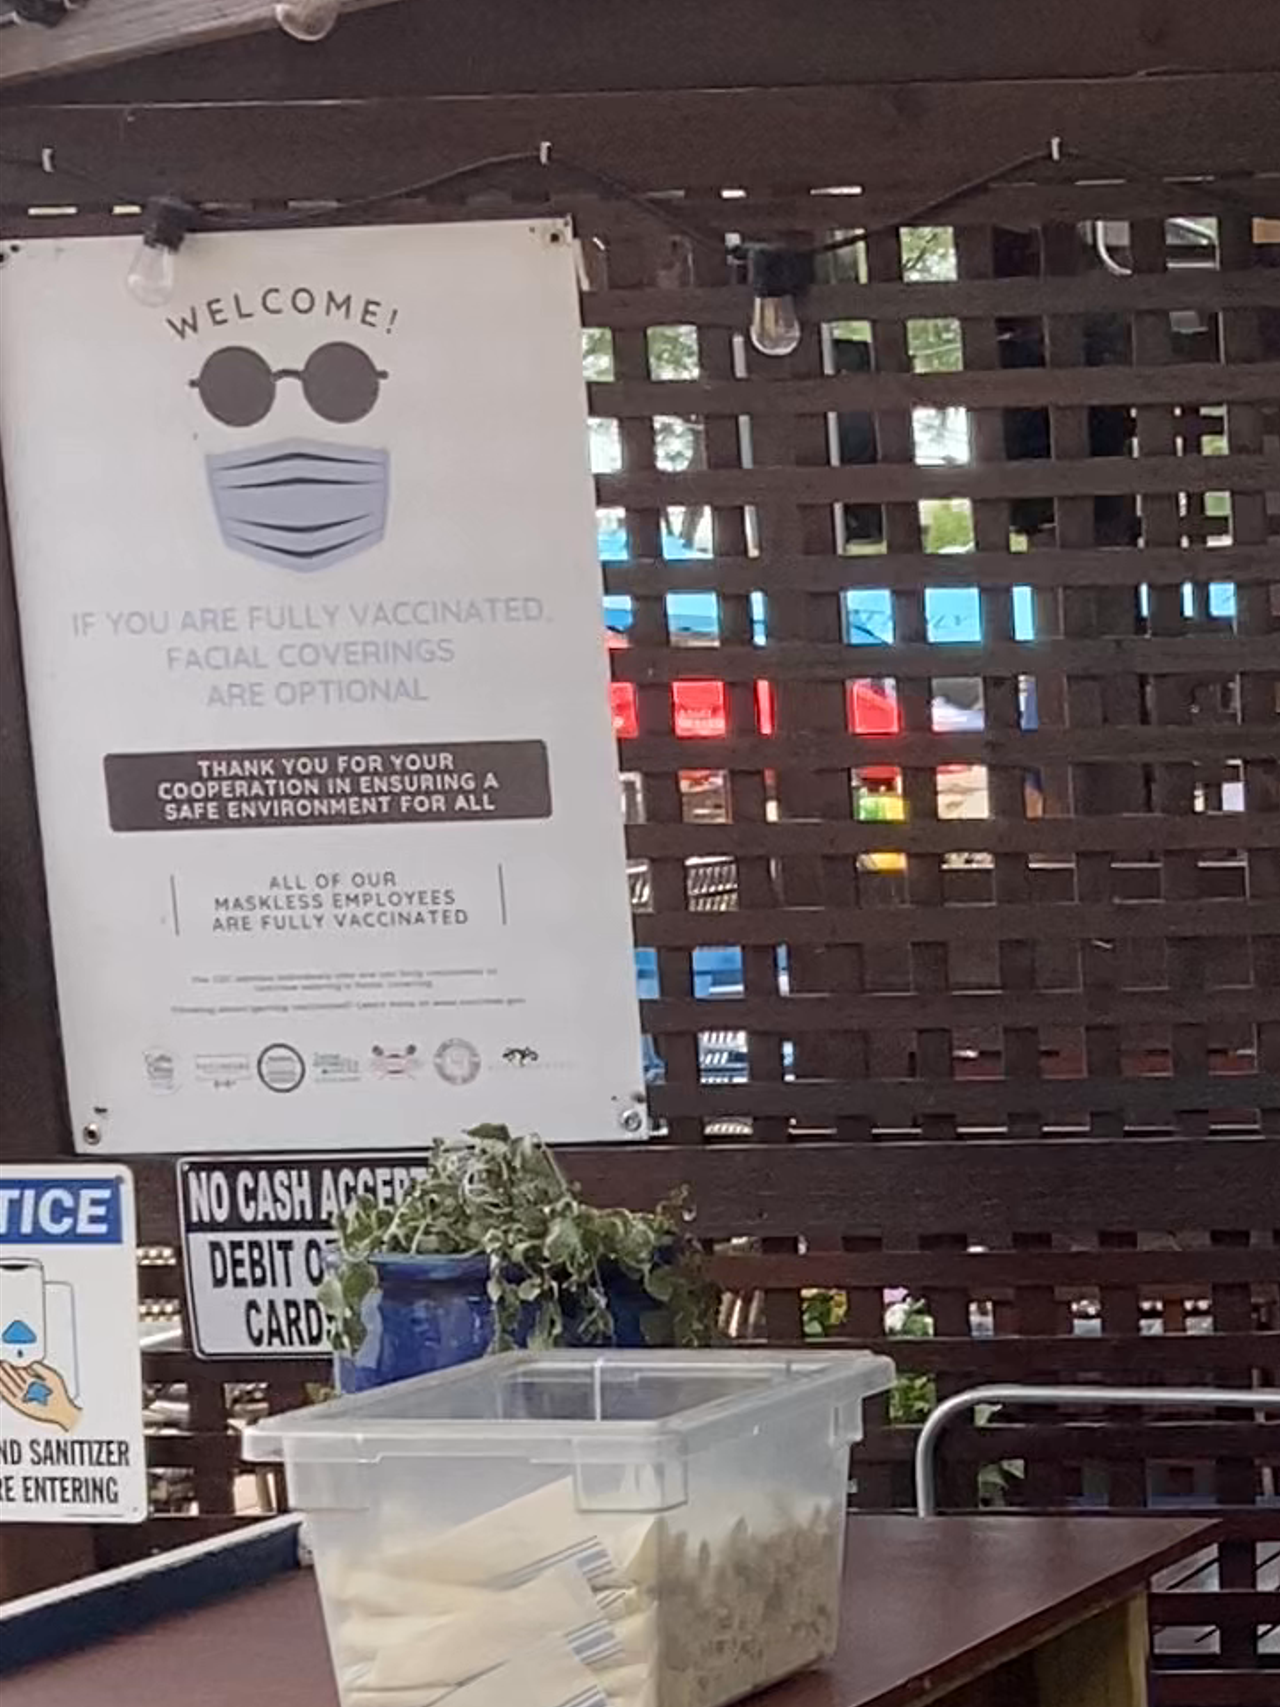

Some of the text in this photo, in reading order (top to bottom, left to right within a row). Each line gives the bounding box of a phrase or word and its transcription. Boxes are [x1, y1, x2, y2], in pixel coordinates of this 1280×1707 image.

[166, 287, 398, 340] WELCOME!
[72, 612, 95, 636] IF
[106, 609, 169, 635] YOU
[181, 607, 238, 632] ARE
[249, 603, 340, 631] FULLY
[166, 638, 455, 671] FACIAL COVERINGS
[206, 677, 429, 707] ARE OPTIONAL
[197, 752, 454, 779] THANK YOU FOR YOUR
[157, 772, 499, 801] COOPERATION IN ENSURING A
[164, 792, 496, 821] SAFE ENVIRONMENT FOR ALL
[269, 871, 397, 891] ALL OF OUR
[214, 890, 456, 911] MASKLESS EMPLOYEES
[212, 909, 470, 933] ARE FULLY VACCINATED
[188, 1168, 314, 1223] NO CASH
[208, 1239, 294, 1288] DEBIT
[29, 1439, 130, 1466] SANITIZER
[22, 1476, 119, 1504] ENTERING
